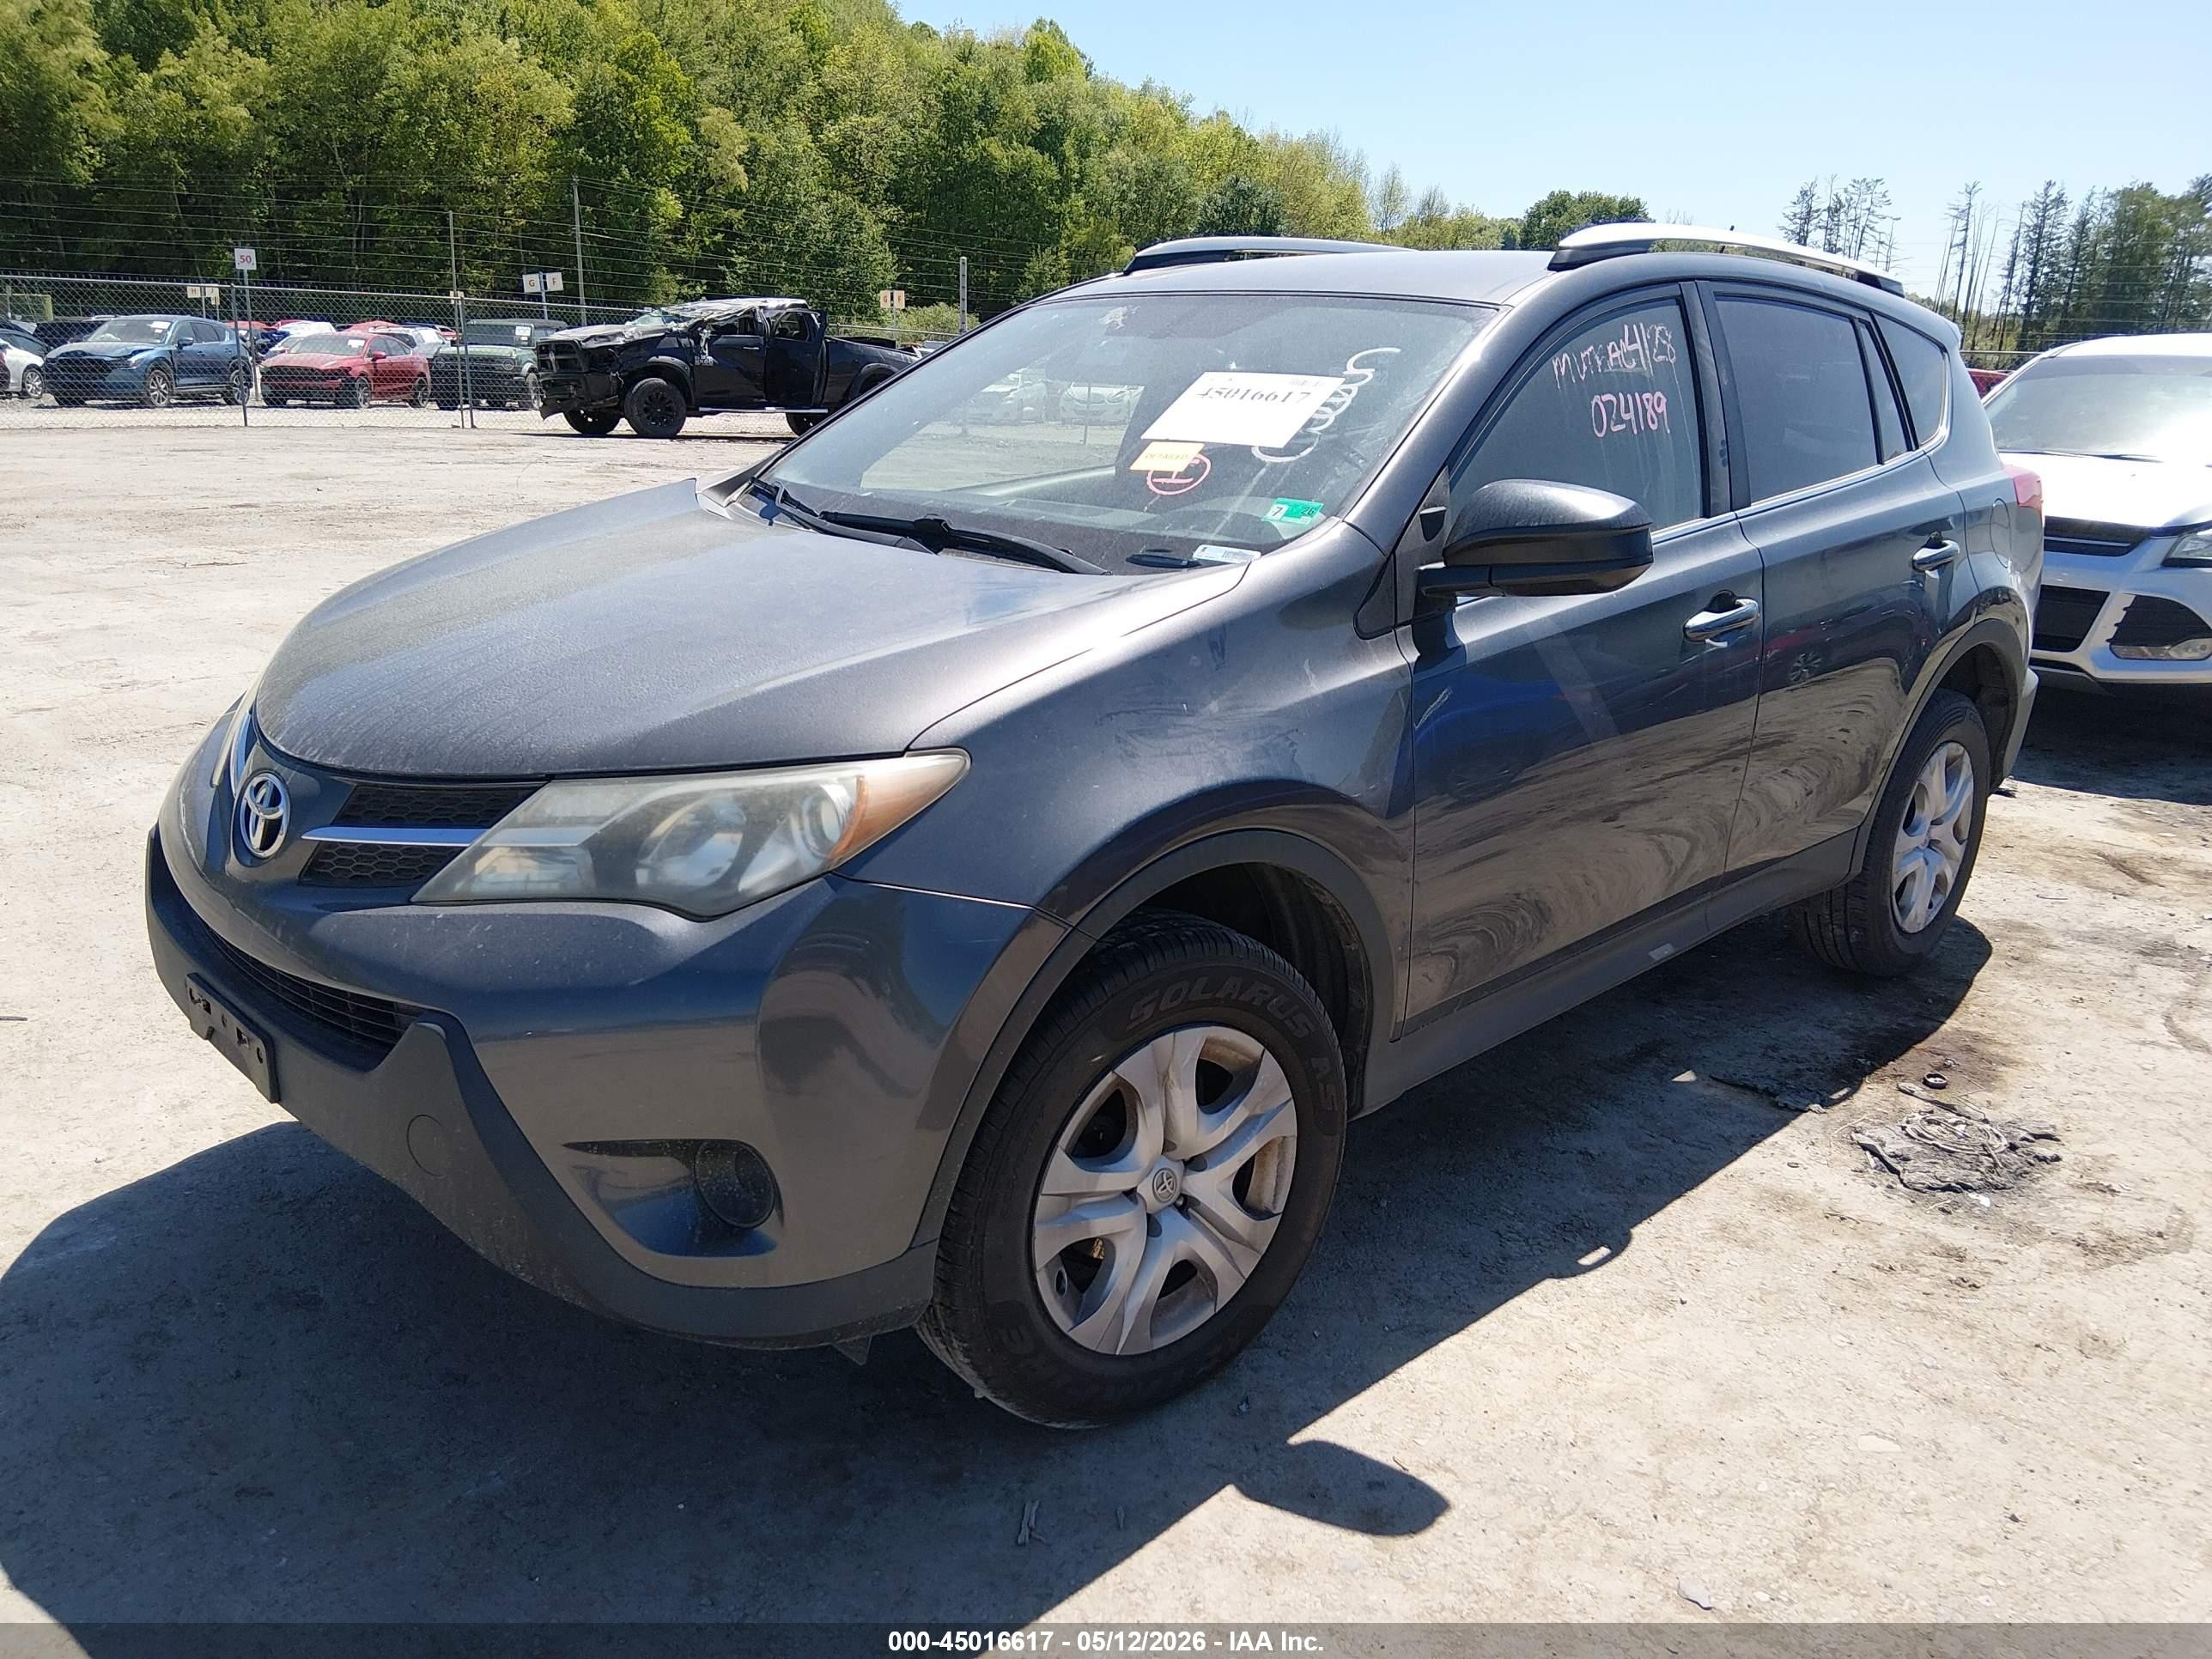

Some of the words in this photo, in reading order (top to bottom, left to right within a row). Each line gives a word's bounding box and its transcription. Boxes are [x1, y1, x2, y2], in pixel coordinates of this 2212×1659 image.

[240, 255, 252, 264] 50
[528, 279, 536, 288] G
[552, 277, 557, 286] F
[1197, 386, 1312, 404] 45016617
[1591, 391, 1671, 438] 024189
[1271, 507, 1284, 517] 7
[1301, 507, 1317, 516] 26
[1126, 975, 1317, 1039] SOLARUS
[1309, 1056, 1338, 1112] AS
